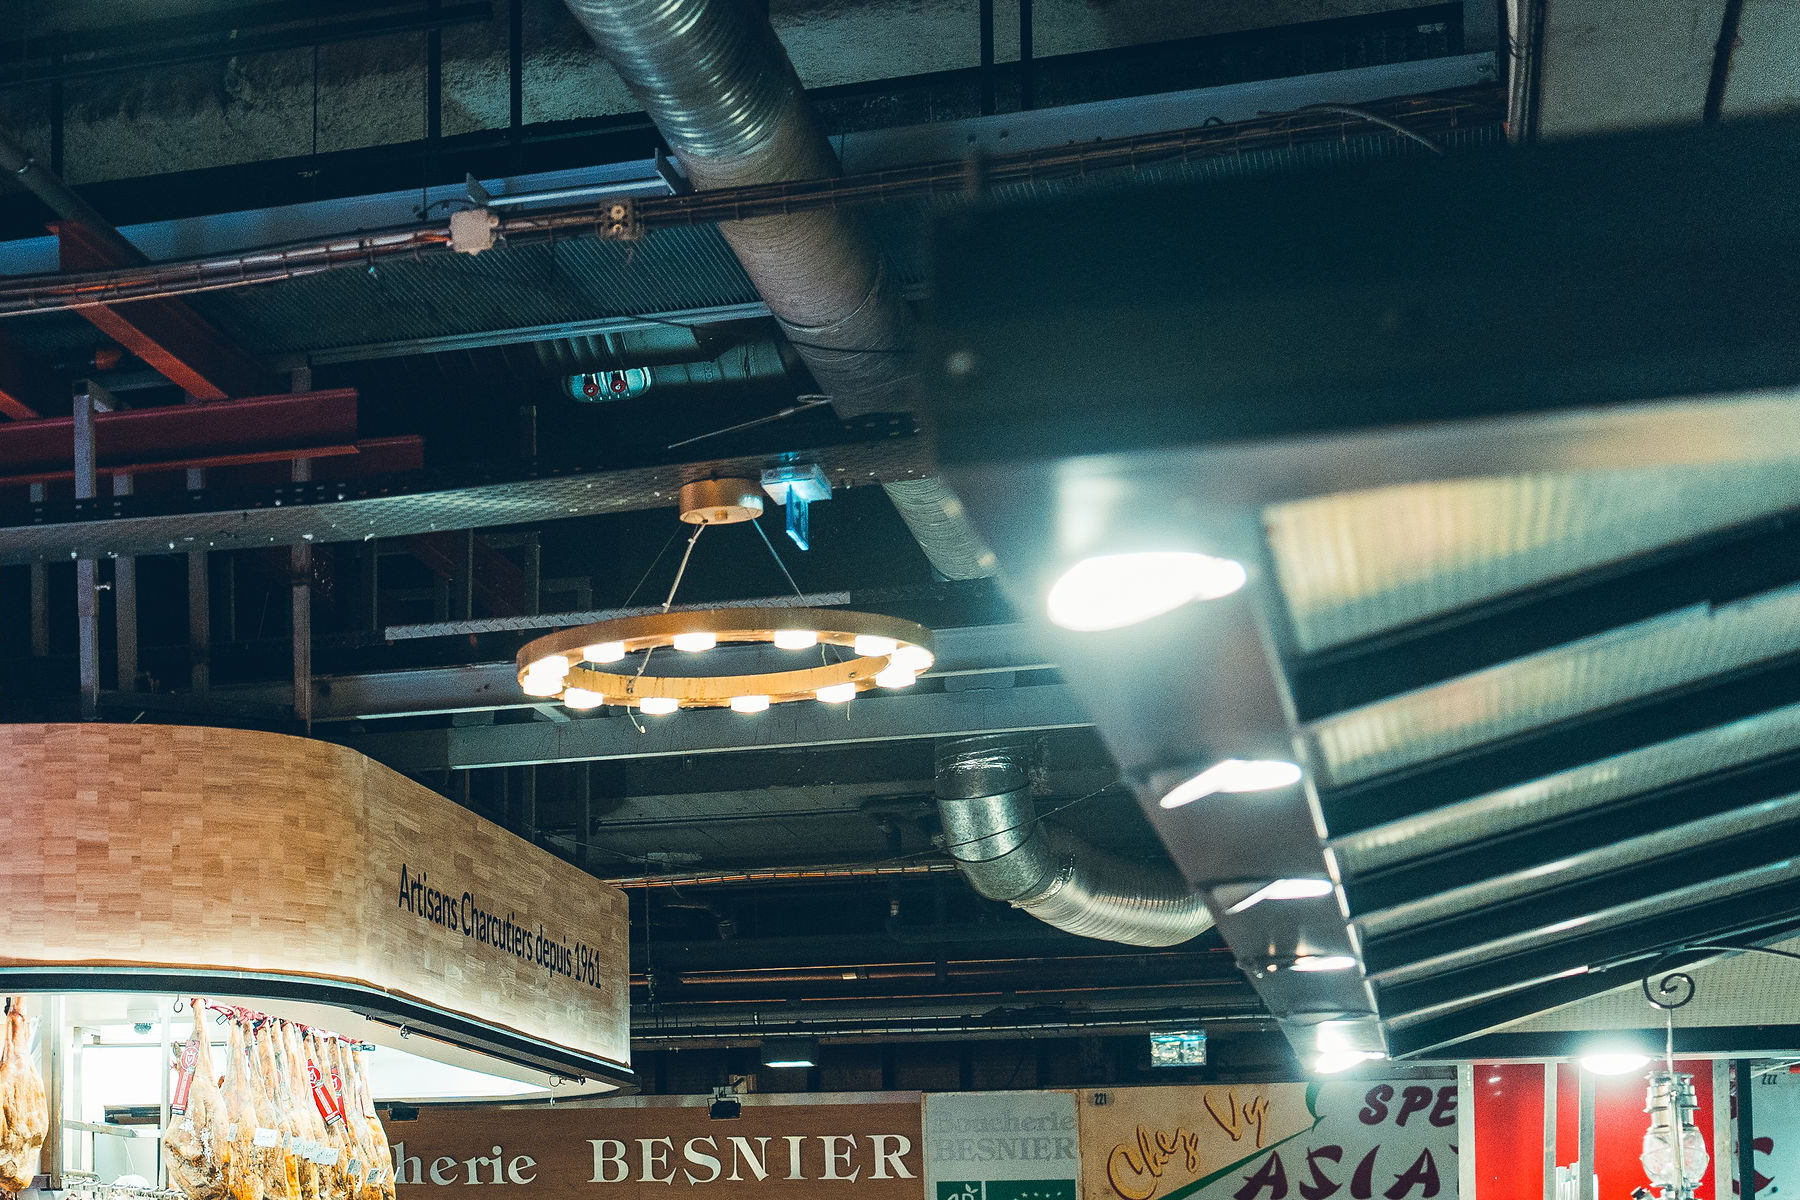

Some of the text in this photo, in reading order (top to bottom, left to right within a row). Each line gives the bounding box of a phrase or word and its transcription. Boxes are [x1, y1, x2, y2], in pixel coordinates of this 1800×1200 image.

[398, 862, 601, 990] Artisans Charcutiers depuis 1961
[933, 1110, 1076, 1133] Boucherie
[1203, 1089, 1270, 1149] Vy
[586, 1133, 918, 1187] BESNIER
[934, 1137, 1077, 1161] BESNIER
[1232, 1144, 1459, 1200] ASIA
